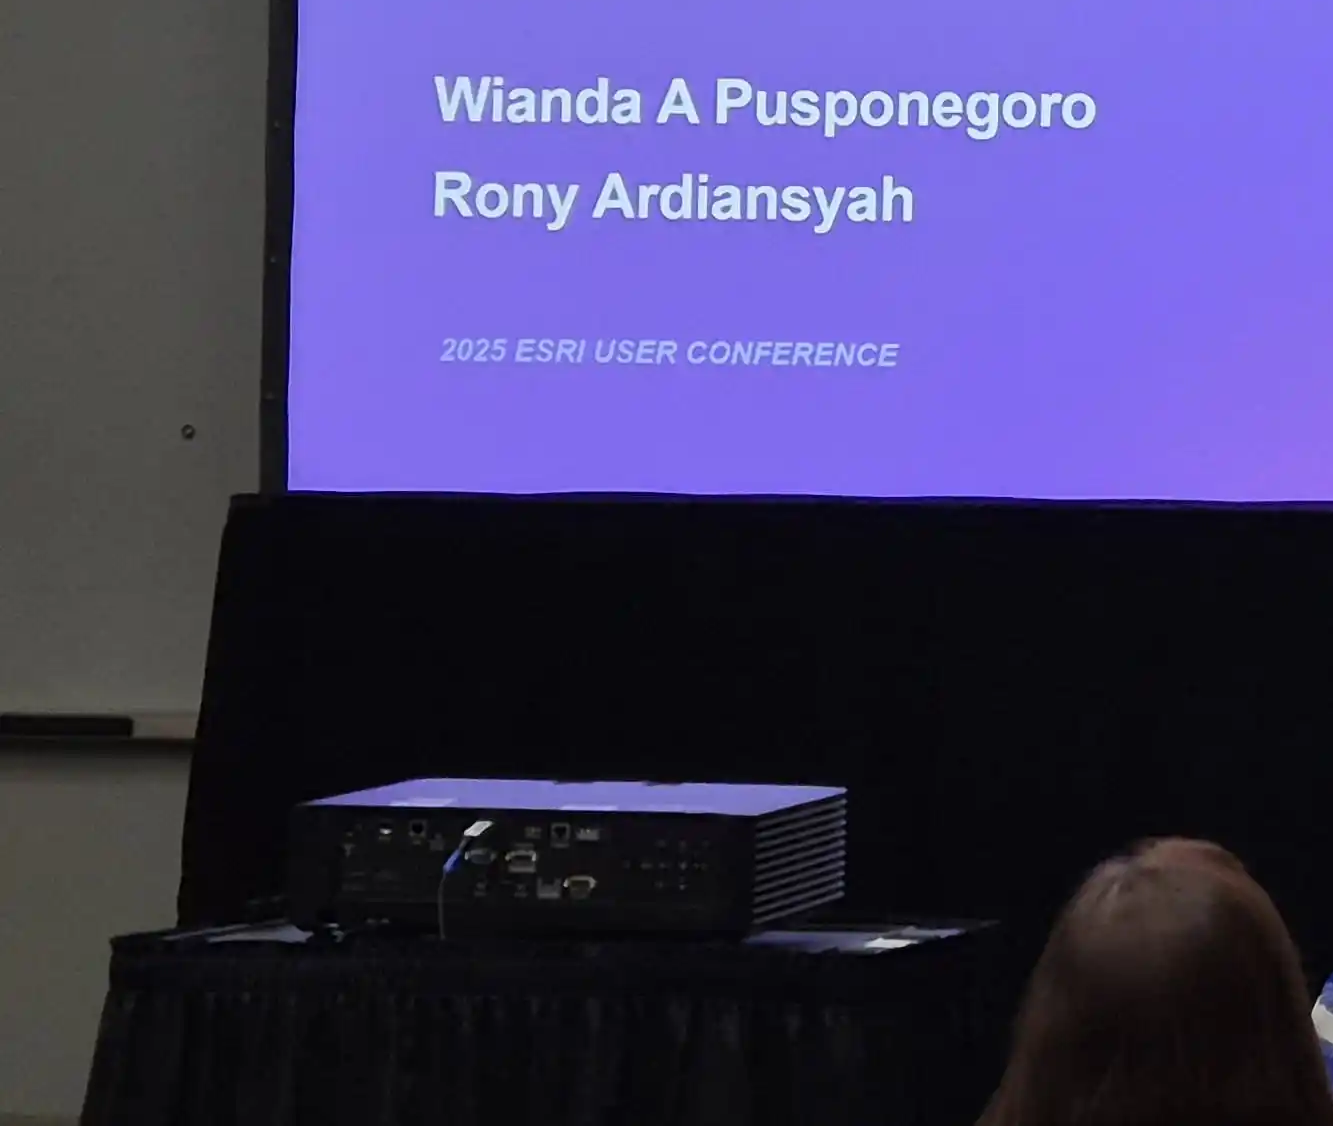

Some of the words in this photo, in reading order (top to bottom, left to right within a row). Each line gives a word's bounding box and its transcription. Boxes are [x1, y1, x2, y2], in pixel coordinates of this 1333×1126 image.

[434, 76, 642, 125] Wianda
[656, 78, 700, 124] A
[715, 79, 1097, 141] Pusponegoro
[433, 171, 580, 231] Rony
[592, 172, 914, 234] Ardiansyah
[440, 338, 508, 363] 2025
[515, 339, 586, 364] ESRI
[593, 339, 678, 365] USER
[686, 340, 900, 367] CONFERENCE
